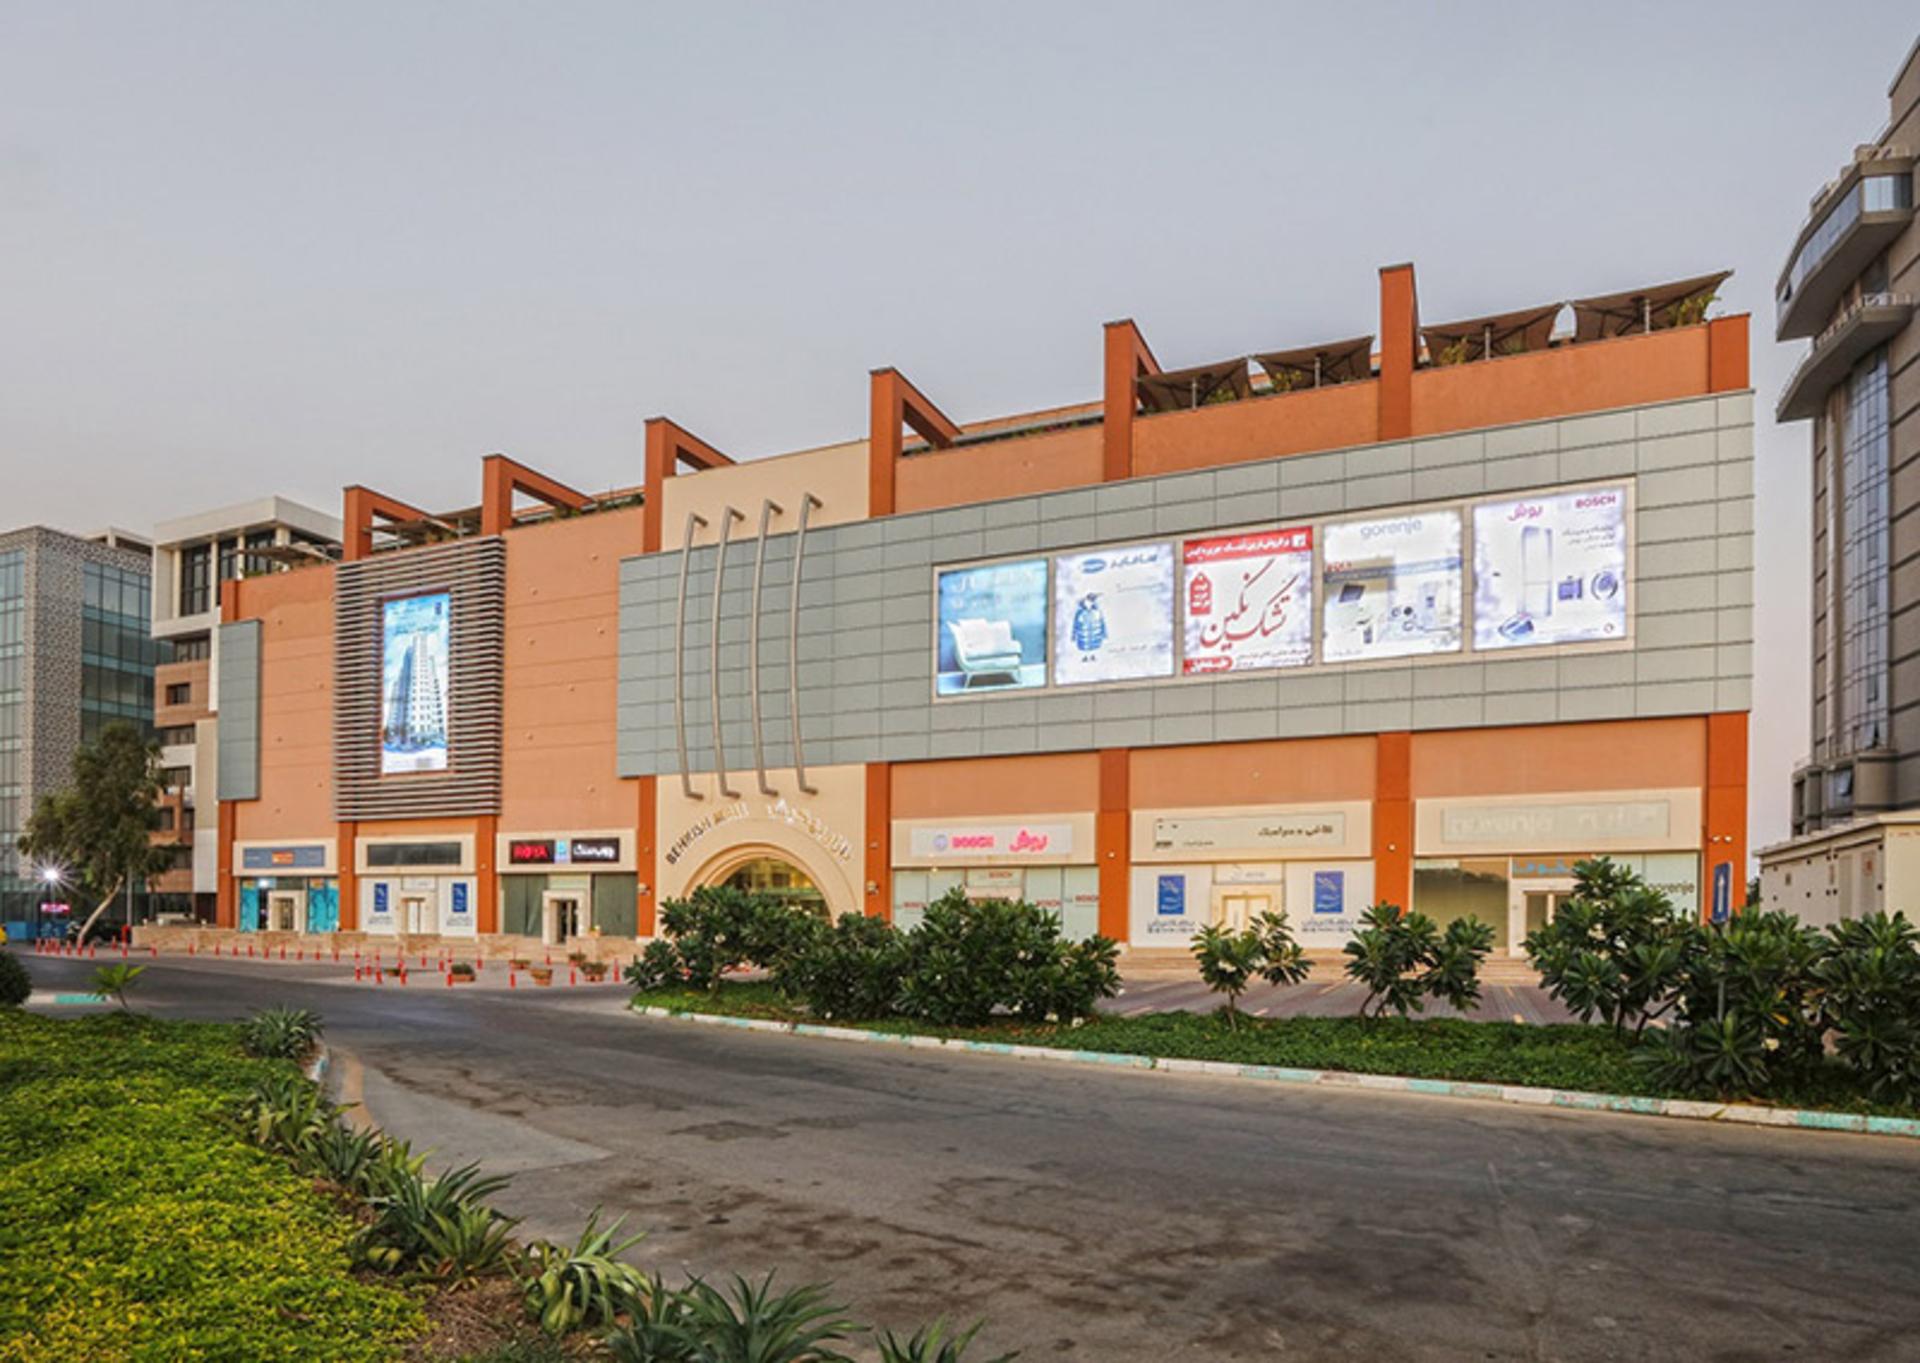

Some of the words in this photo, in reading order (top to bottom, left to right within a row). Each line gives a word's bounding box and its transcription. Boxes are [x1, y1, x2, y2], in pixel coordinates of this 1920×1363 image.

[1575, 495, 1616, 509] BOSCH
[1508, 503, 1543, 521] بوش
[1360, 517, 1422, 539] gorenje
[952, 836, 994, 849] BOSCH
[1009, 828, 1048, 853] بوش
